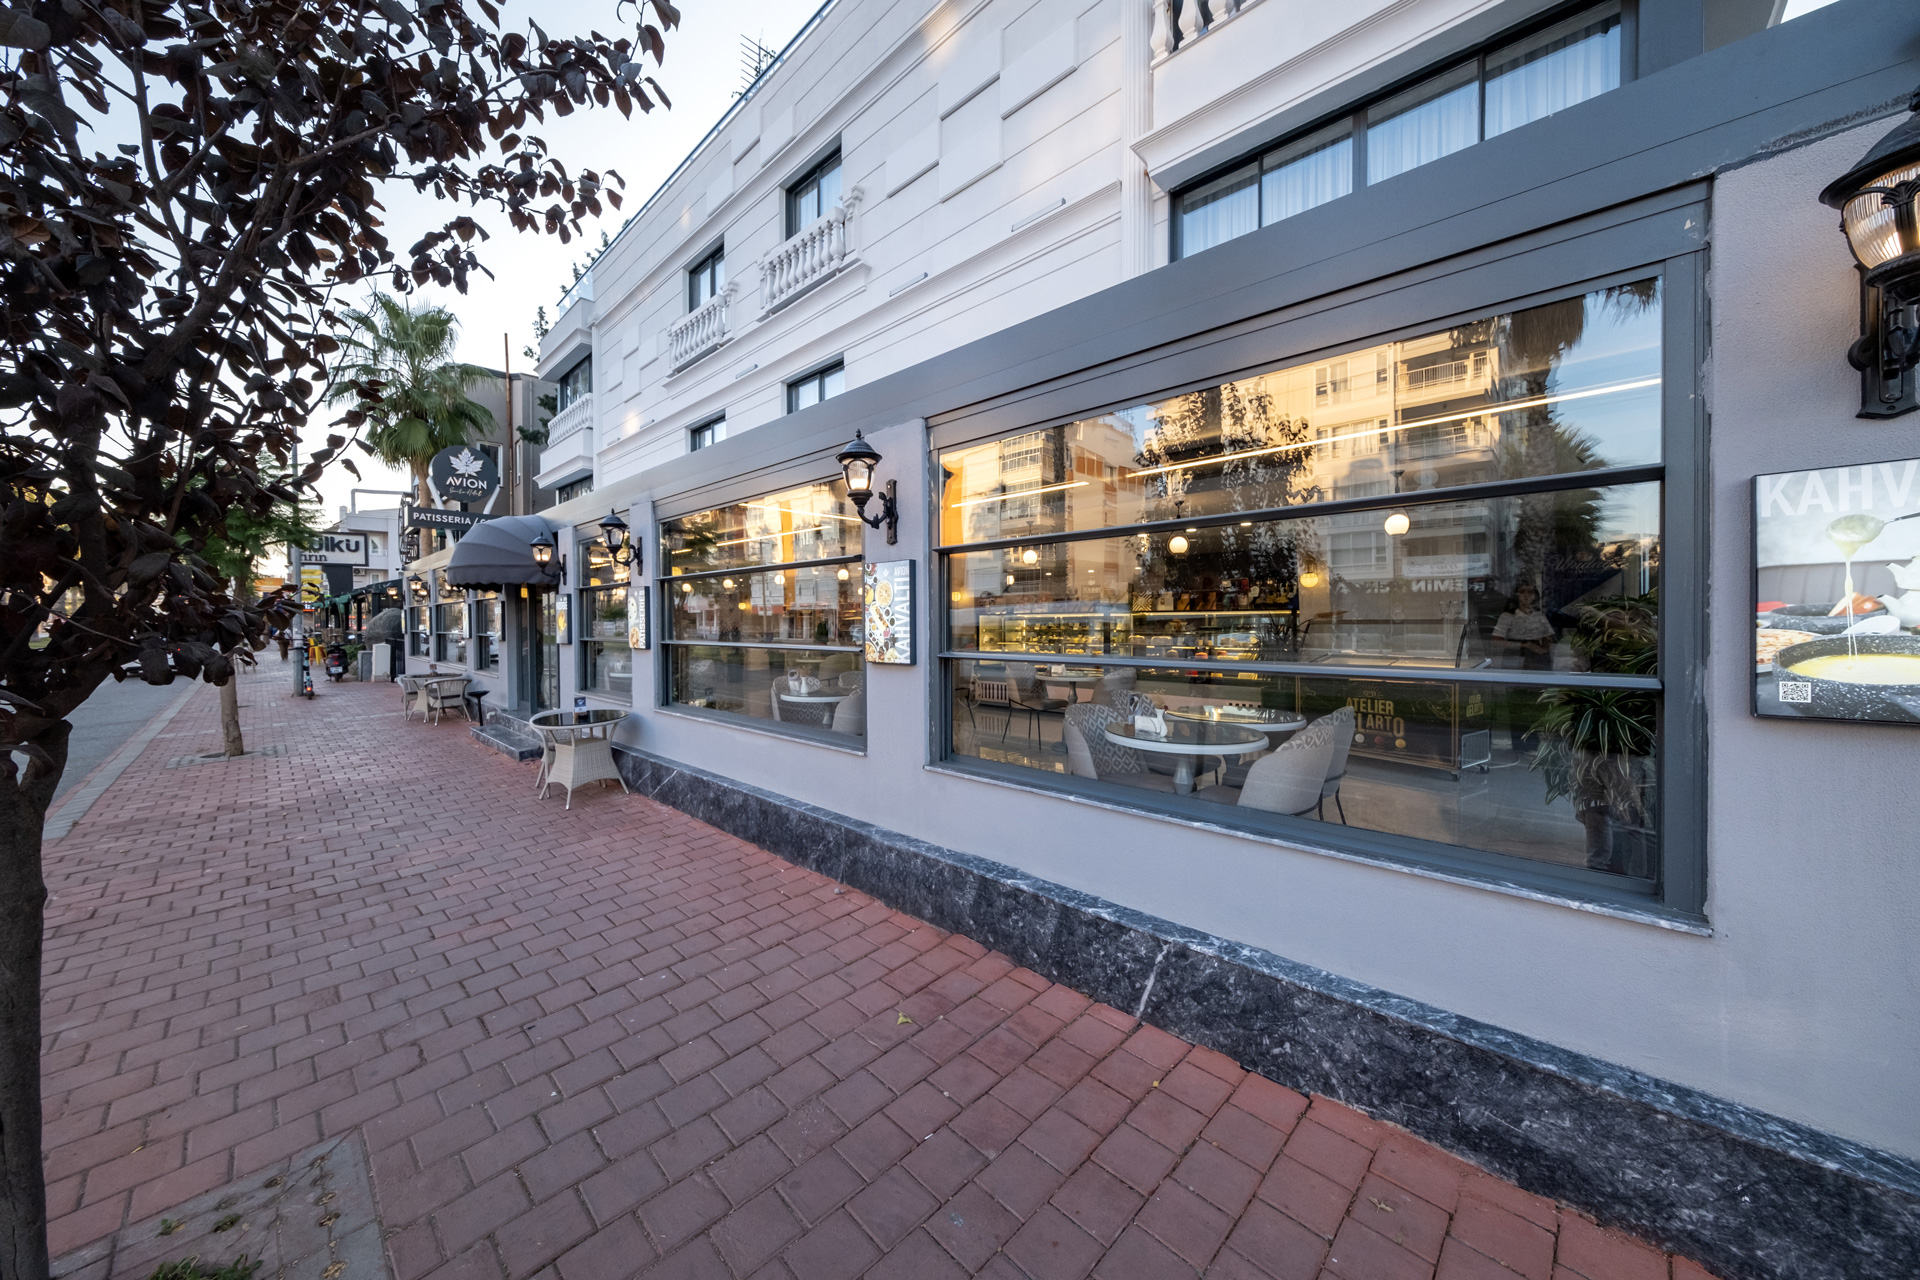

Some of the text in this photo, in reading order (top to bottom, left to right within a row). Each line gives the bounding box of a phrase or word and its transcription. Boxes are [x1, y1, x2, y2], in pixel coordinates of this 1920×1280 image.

[446, 476, 487, 490] AVION
[1760, 460, 1920, 518] KAHV
[413, 512, 472, 525] PATISSERIA
[893, 576, 911, 663] KAHVALTI
[1346, 697, 1394, 716] ATELIER
[1354, 713, 1405, 738] LARTO
